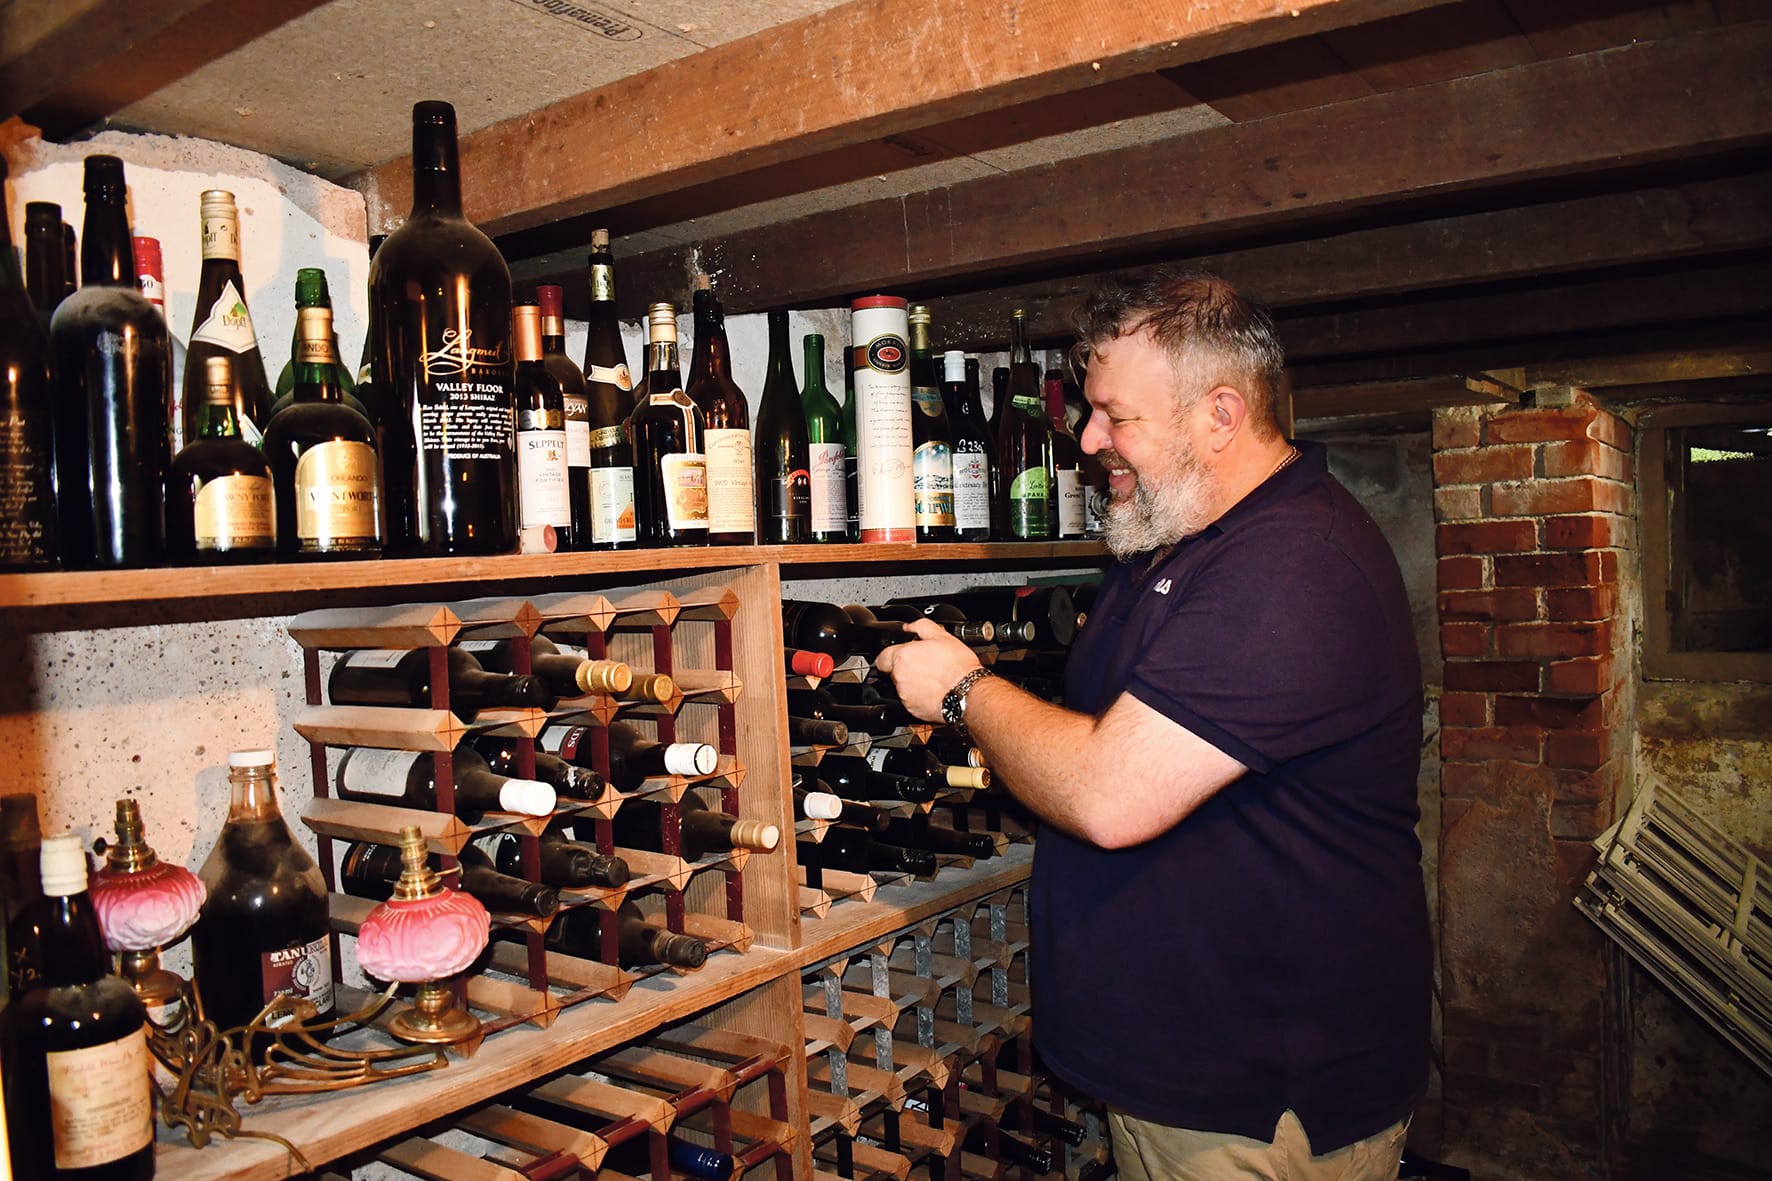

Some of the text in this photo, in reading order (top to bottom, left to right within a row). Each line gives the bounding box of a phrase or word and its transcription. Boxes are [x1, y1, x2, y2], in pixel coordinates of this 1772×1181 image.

[436, 382, 504, 394] VALLEY FLOOR
[528, 439, 564, 451] SEPPELT
